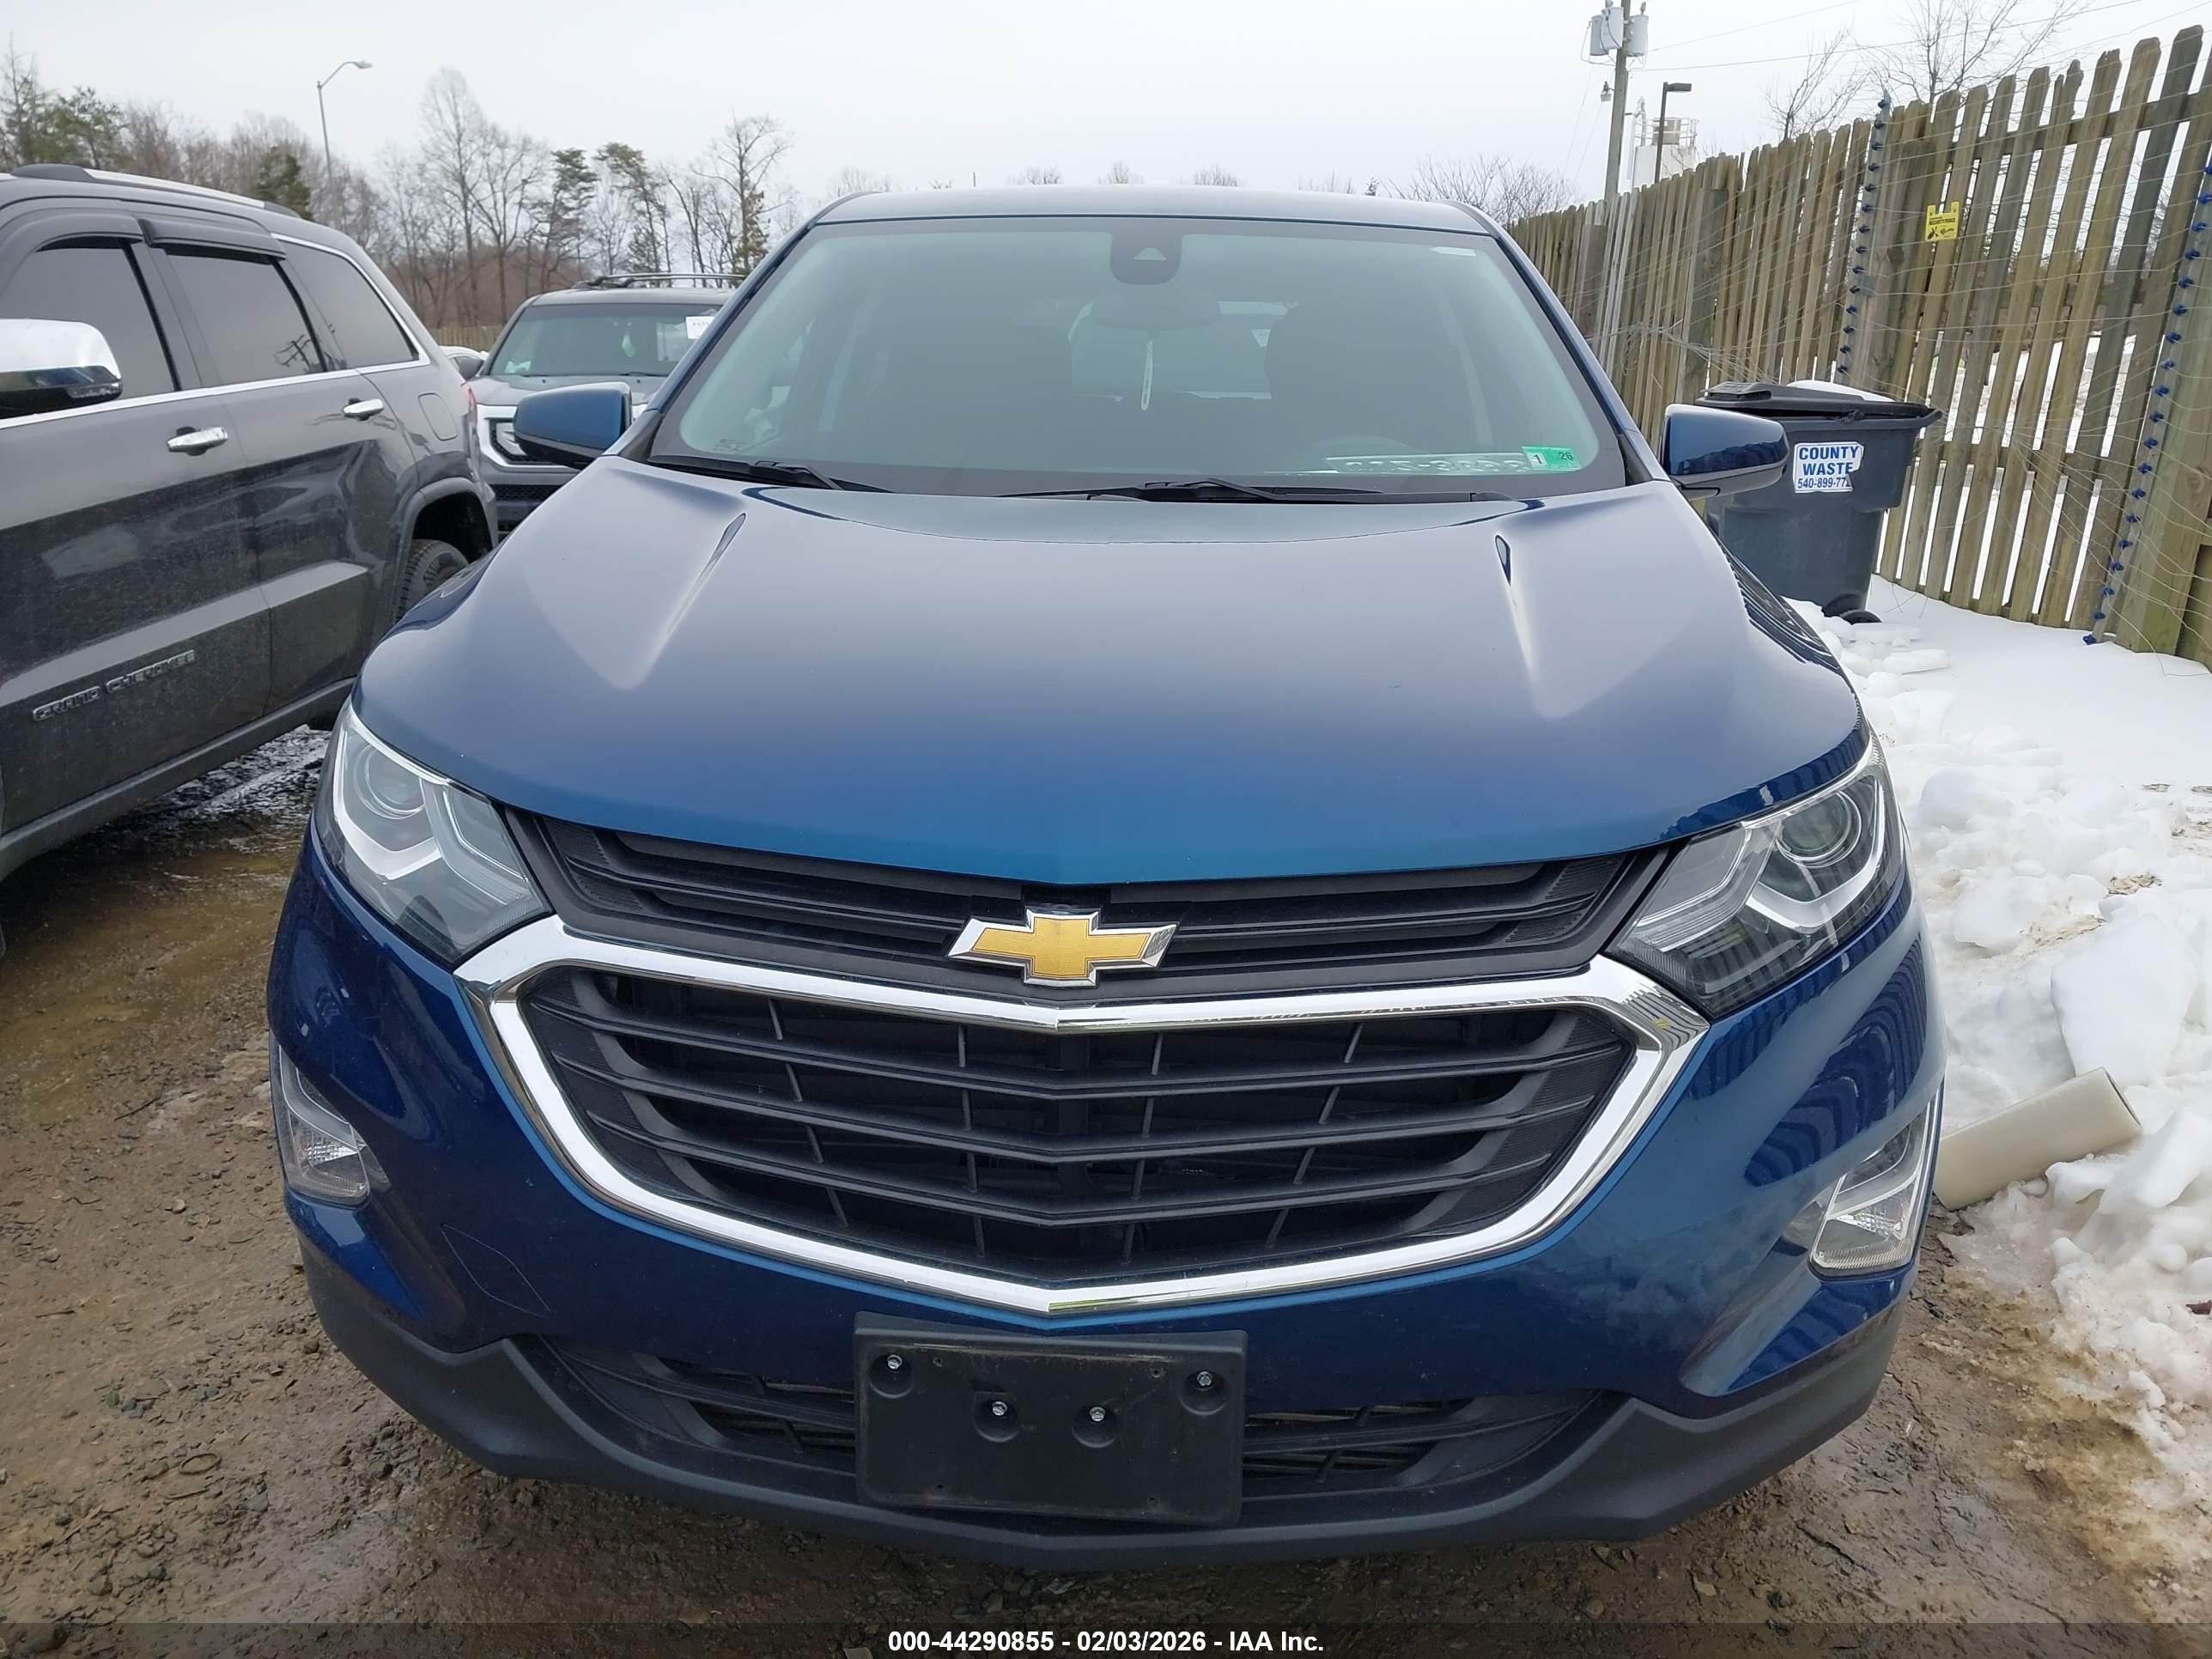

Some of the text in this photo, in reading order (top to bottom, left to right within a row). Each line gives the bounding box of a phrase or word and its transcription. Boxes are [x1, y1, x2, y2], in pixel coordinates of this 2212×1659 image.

[1559, 451, 1573, 460] 26
[1799, 447, 1859, 460] COUNTY
[1803, 463, 1853, 475] WASTE
[33, 649, 196, 722] GRAND CHEROKEE
